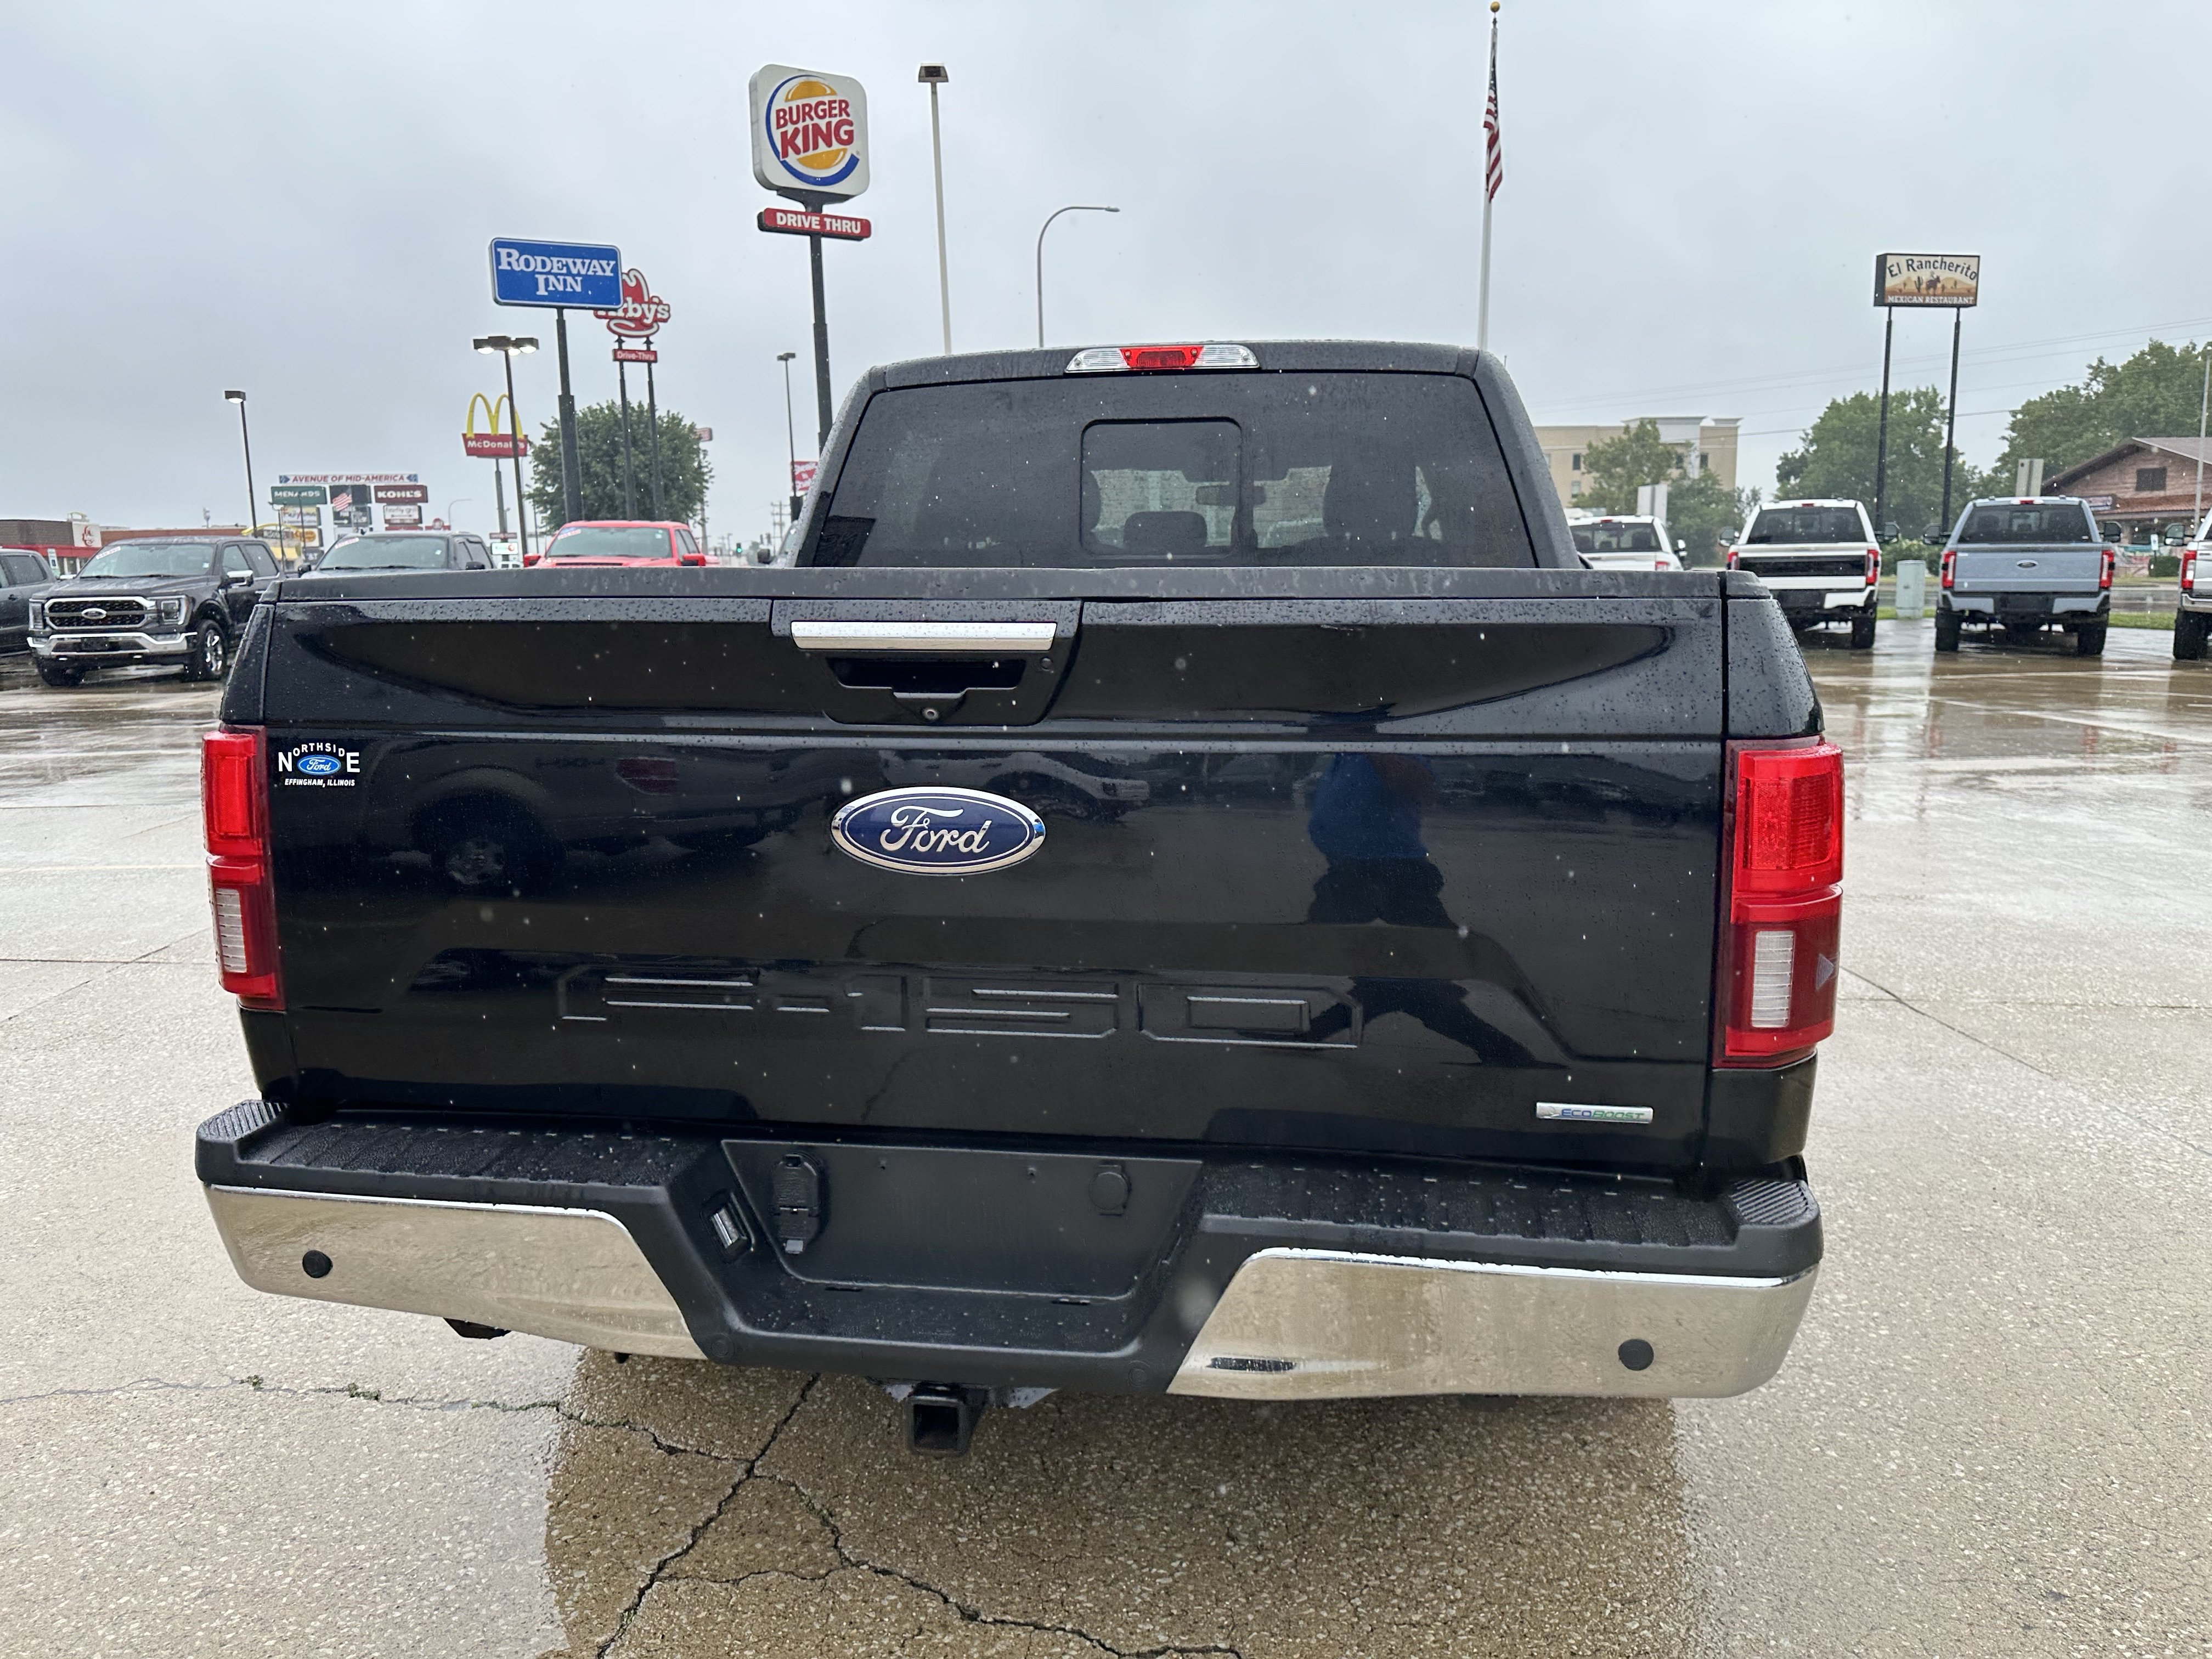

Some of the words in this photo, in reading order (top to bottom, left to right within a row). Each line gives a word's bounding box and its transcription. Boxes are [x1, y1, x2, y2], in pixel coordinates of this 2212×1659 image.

[775, 99, 850, 129] BURGER
[780, 119, 854, 159] KING
[776, 212, 821, 230] DRIVE
[824, 217, 861, 234] THRU
[496, 247, 616, 276] RODEWAY
[1887, 262, 1902, 278] El
[1906, 257, 1978, 280] Rancherito
[535, 274, 582, 296] INN
[597, 296, 670, 324] rby's
[1887, 295, 1924, 303] MEXICAN
[617, 351, 654, 360] Drive-Thru
[467, 440, 525, 449] McDonal's
[345, 474, 404, 482] MID-AMERICA
[278, 742, 360, 772] NORTHSIDE
[307, 759, 331, 771] Ford
[285, 778, 325, 788] EFFINGHAM,
[880, 805, 992, 853] Ford
